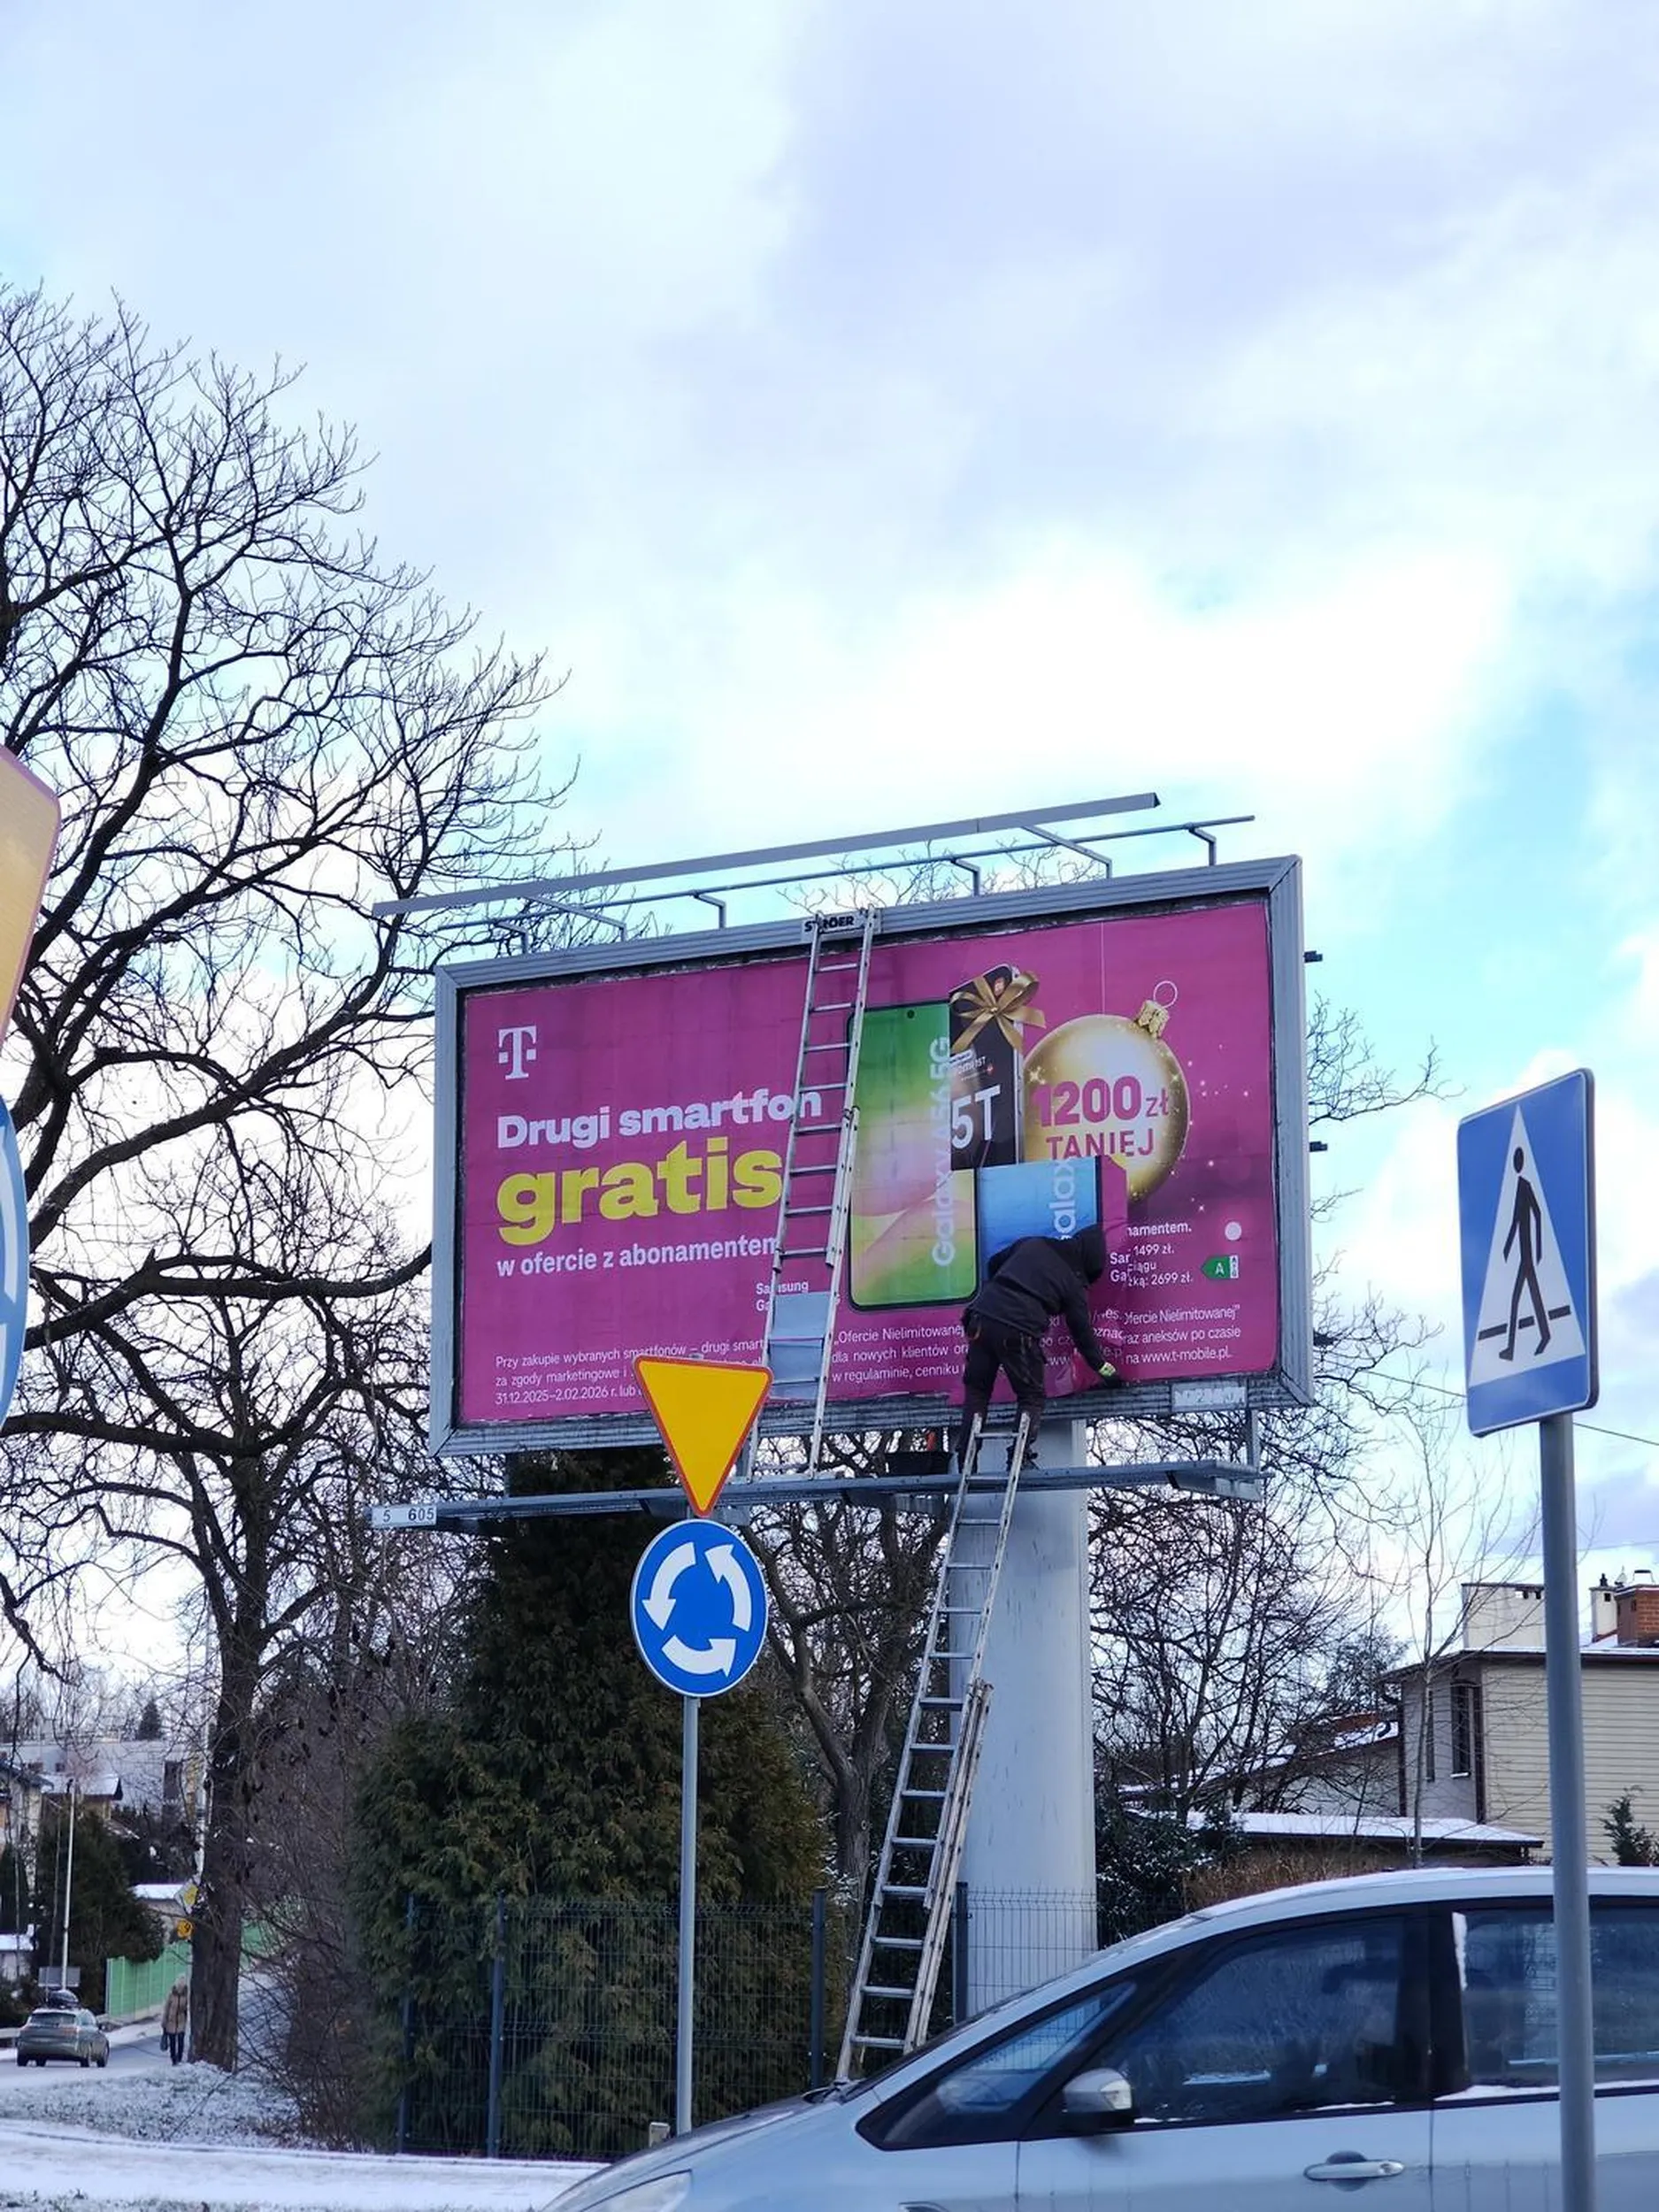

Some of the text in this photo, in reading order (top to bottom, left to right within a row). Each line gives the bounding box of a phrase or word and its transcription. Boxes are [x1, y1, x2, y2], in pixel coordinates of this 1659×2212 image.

[804, 915, 855, 932] SRÖER
[930, 1036, 950, 1079] 5G
[1031, 1076, 1170, 1128] 1200 zł
[497, 1088, 822, 1148] Drugi smartfon
[1046, 1128, 1154, 1160] TANIEJ
[497, 1136, 783, 1246] gratis
[1049, 1158, 1077, 1240] alax
[932, 1149, 956, 1266] Galaxy
[1133, 1243, 1159, 1256] 1499
[497, 1258, 515, 1277] w
[520, 1248, 596, 1276] ofercie
[603, 1250, 614, 1269] z
[1214, 1263, 1225, 1275] A
[756, 1280, 809, 1294] Sasung
[1151, 1272, 1179, 1286] 2699
[1141, 1328, 1188, 1344] aneksów
[1191, 1329, 1205, 1342] po
[1208, 1325, 1241, 1340] czasie
[495, 1356, 518, 1369] Przy
[522, 1352, 559, 1367] zakupie
[564, 1348, 619, 1364] wybranych
[702, 1340, 729, 1356] drugi
[733, 1339, 765, 1350] smart
[832, 1352, 849, 1363] dla
[853, 1348, 897, 1363] nowych
[902, 1345, 949, 1359] klientów
[1125, 1354, 1140, 1364] na
[495, 1377, 507, 1386] za
[511, 1372, 541, 1388] zgody
[546, 1367, 619, 1383] marketingowe
[832, 1363, 959, 1384] w regulaminie, cenniku
[619, 1386, 636, 1397] lub
[408, 1508, 434, 1522] 605
